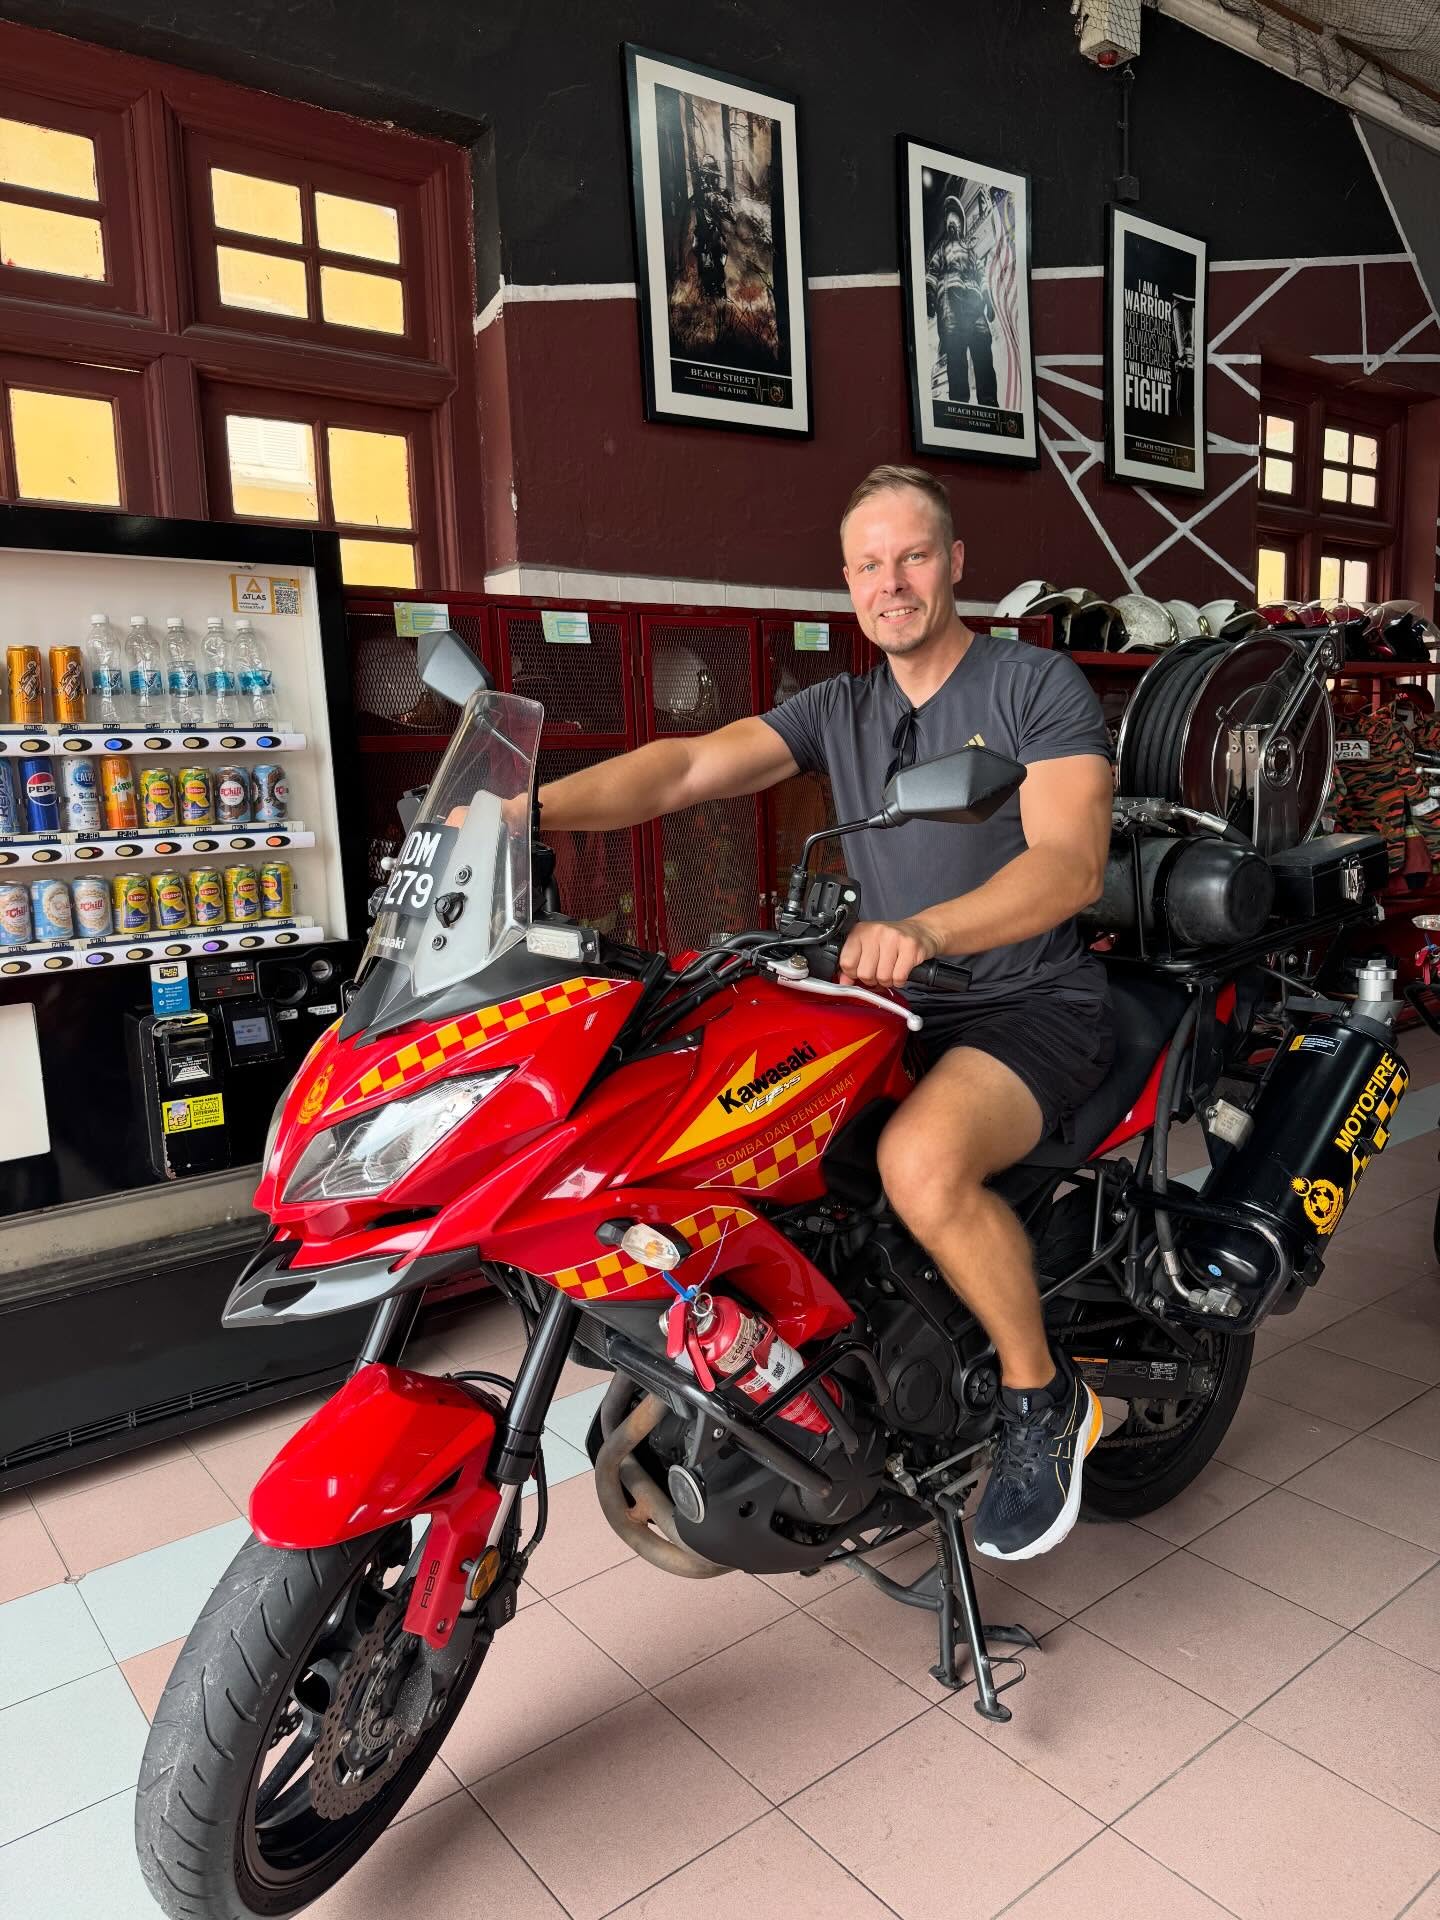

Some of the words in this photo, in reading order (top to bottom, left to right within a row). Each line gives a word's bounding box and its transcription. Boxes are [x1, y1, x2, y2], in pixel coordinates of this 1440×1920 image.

[1143, 280, 1153, 297] AM
[1154, 284, 1159, 298] A
[1124, 288, 1172, 322] WARRIOR
[1124, 310, 1139, 328] NOT
[1140, 313, 1172, 339] BECAUSE
[1124, 341, 1139, 360] BUT
[1140, 346, 1172, 370] BECAUSE
[690, 368, 721, 380] BEACH
[722, 373, 756, 385] STREET
[1129, 360, 1145, 378] WILL
[1146, 365, 1172, 385] ALWAYS
[718, 385, 748, 395] STATION
[1125, 373, 1172, 417] FIGHT
[947, 406, 971, 416] BEACH
[971, 409, 997, 419] STREET
[241, 593, 267, 601] ATLAS
[717, 1040, 817, 1114] Kawasaki
[1334, 1052, 1397, 1153] MOTOFIRE
[716, 1138, 765, 1170] BOMBA
[764, 1120, 790, 1143] DAN
[791, 1073, 857, 1126] PENYELAMAT
[420, 1559, 441, 1609] ABS
